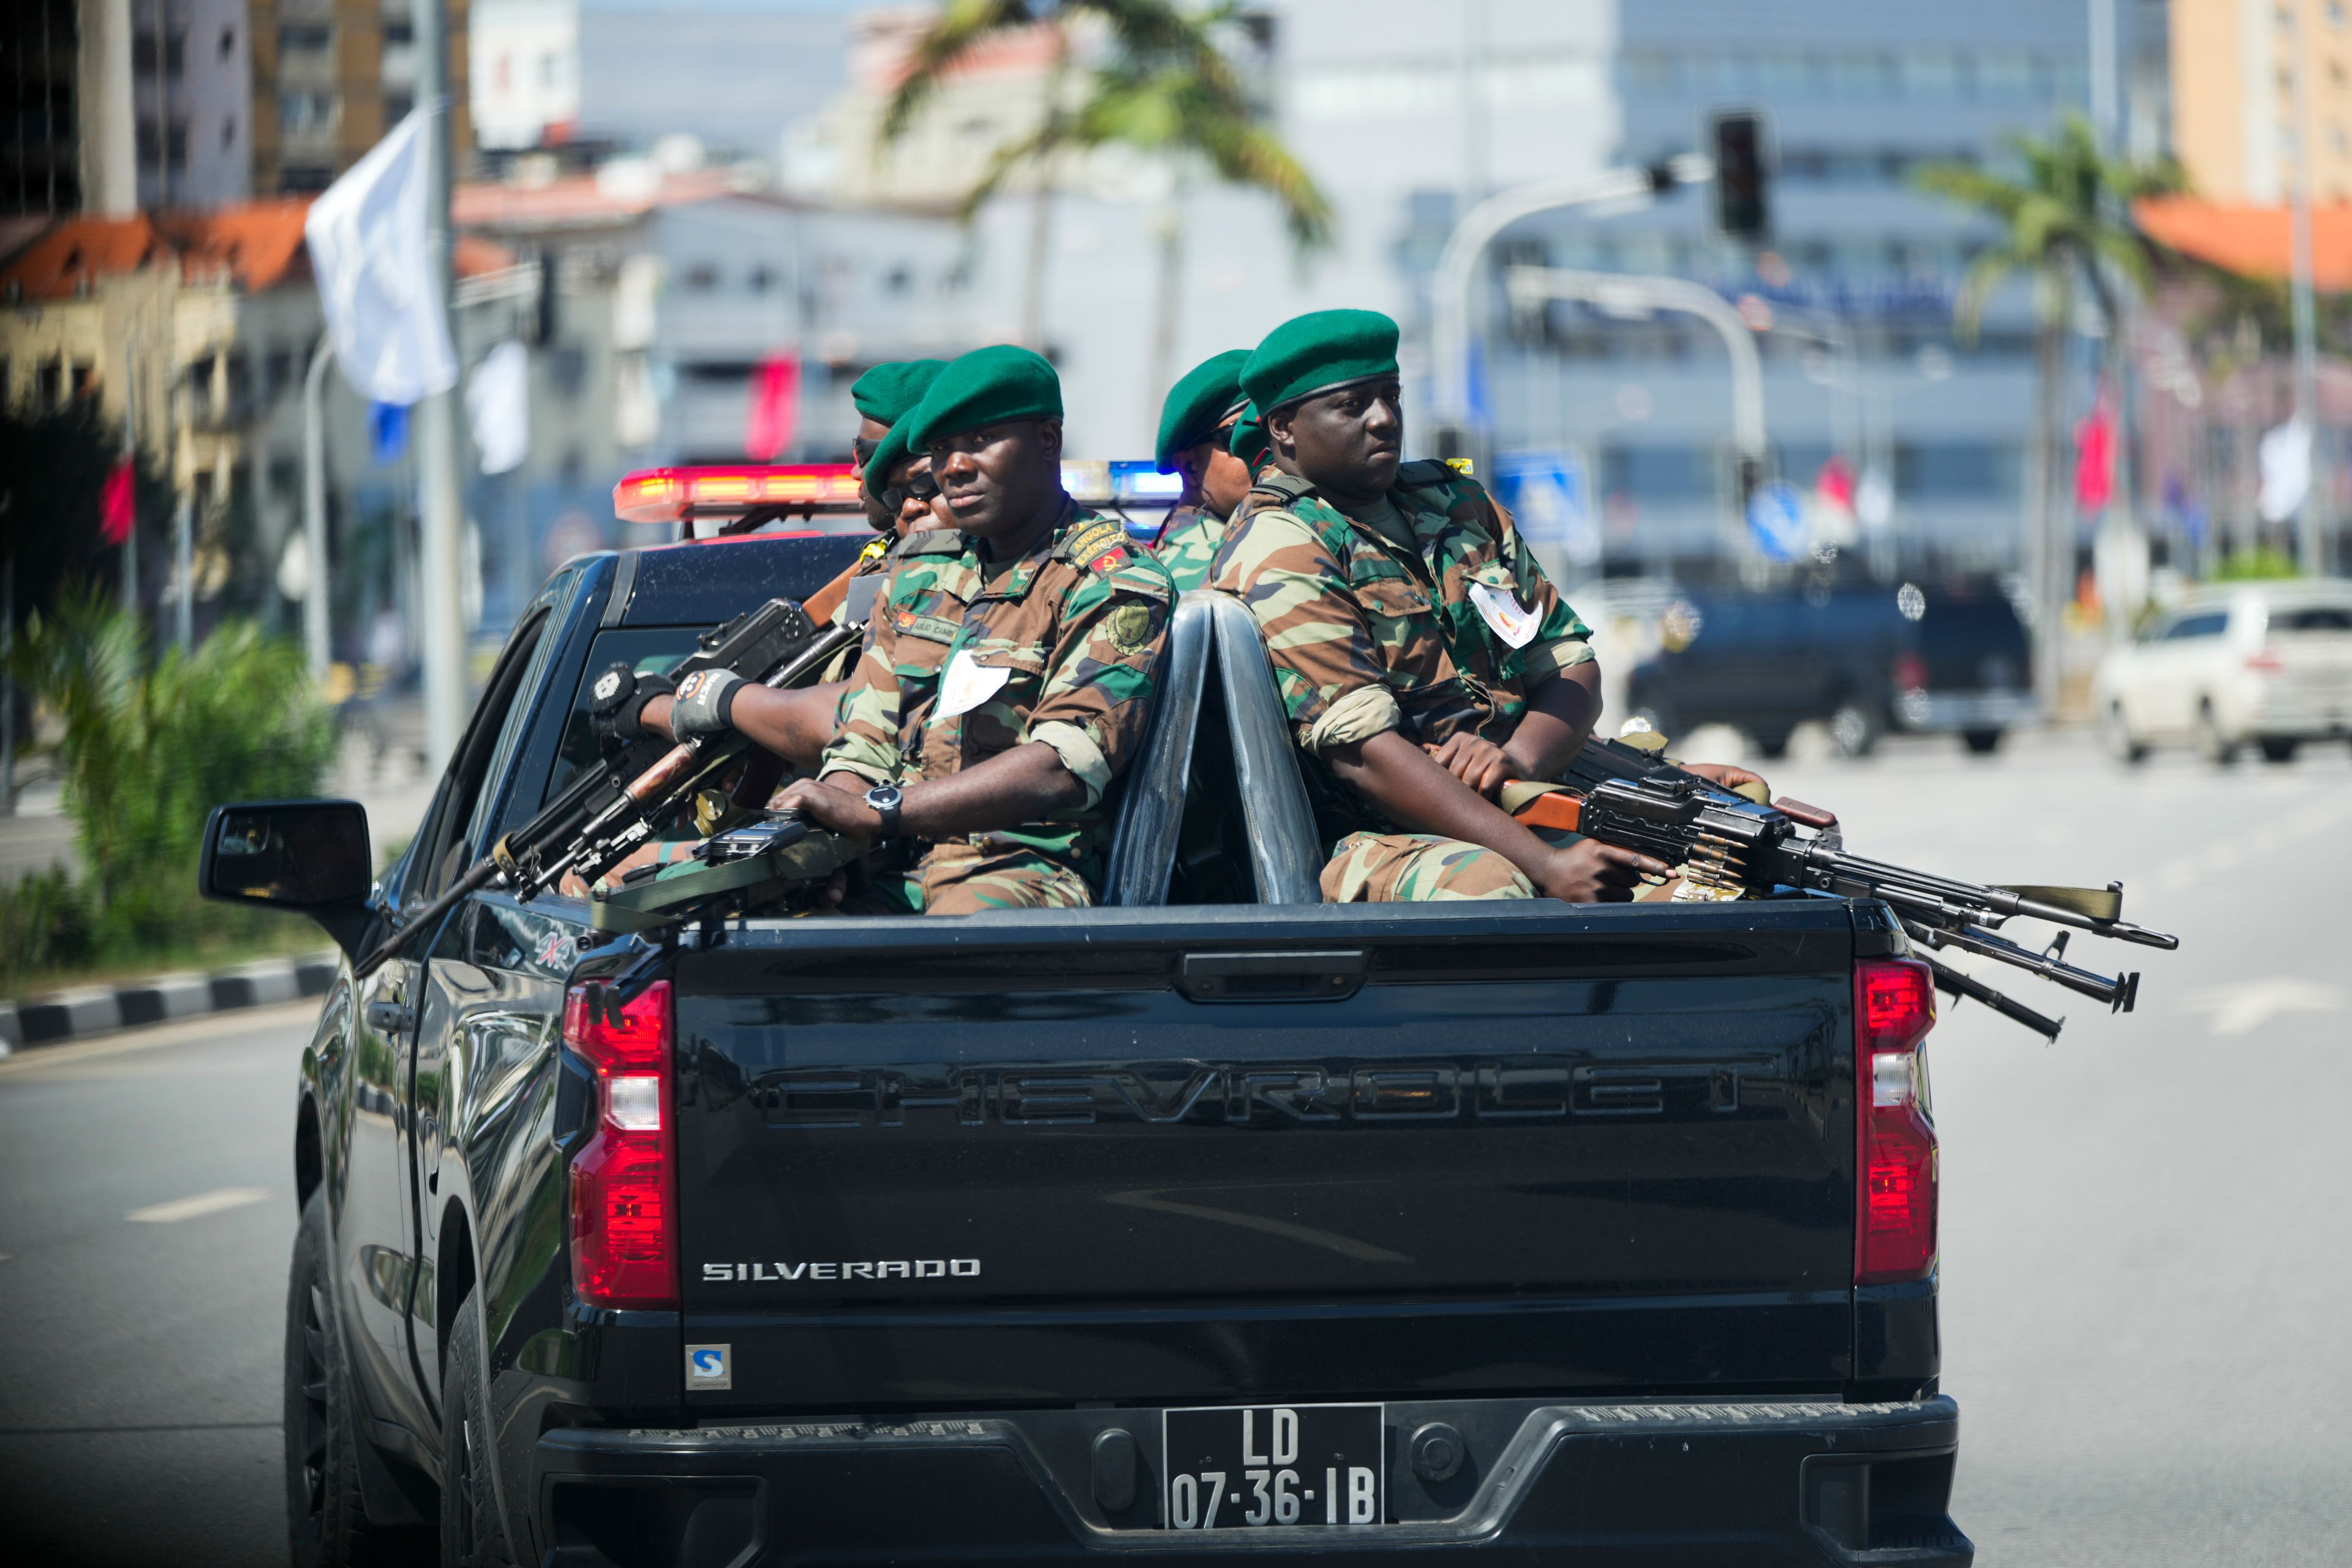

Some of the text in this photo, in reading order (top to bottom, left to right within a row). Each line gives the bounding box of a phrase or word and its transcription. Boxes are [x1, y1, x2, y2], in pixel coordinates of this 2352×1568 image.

[1074, 523, 1113, 551] ANGOLA
[761, 1058, 1775, 1129] CHEVROLET
[703, 1259, 980, 1281] SILVERADO
[1243, 1409, 1298, 1465] LD
